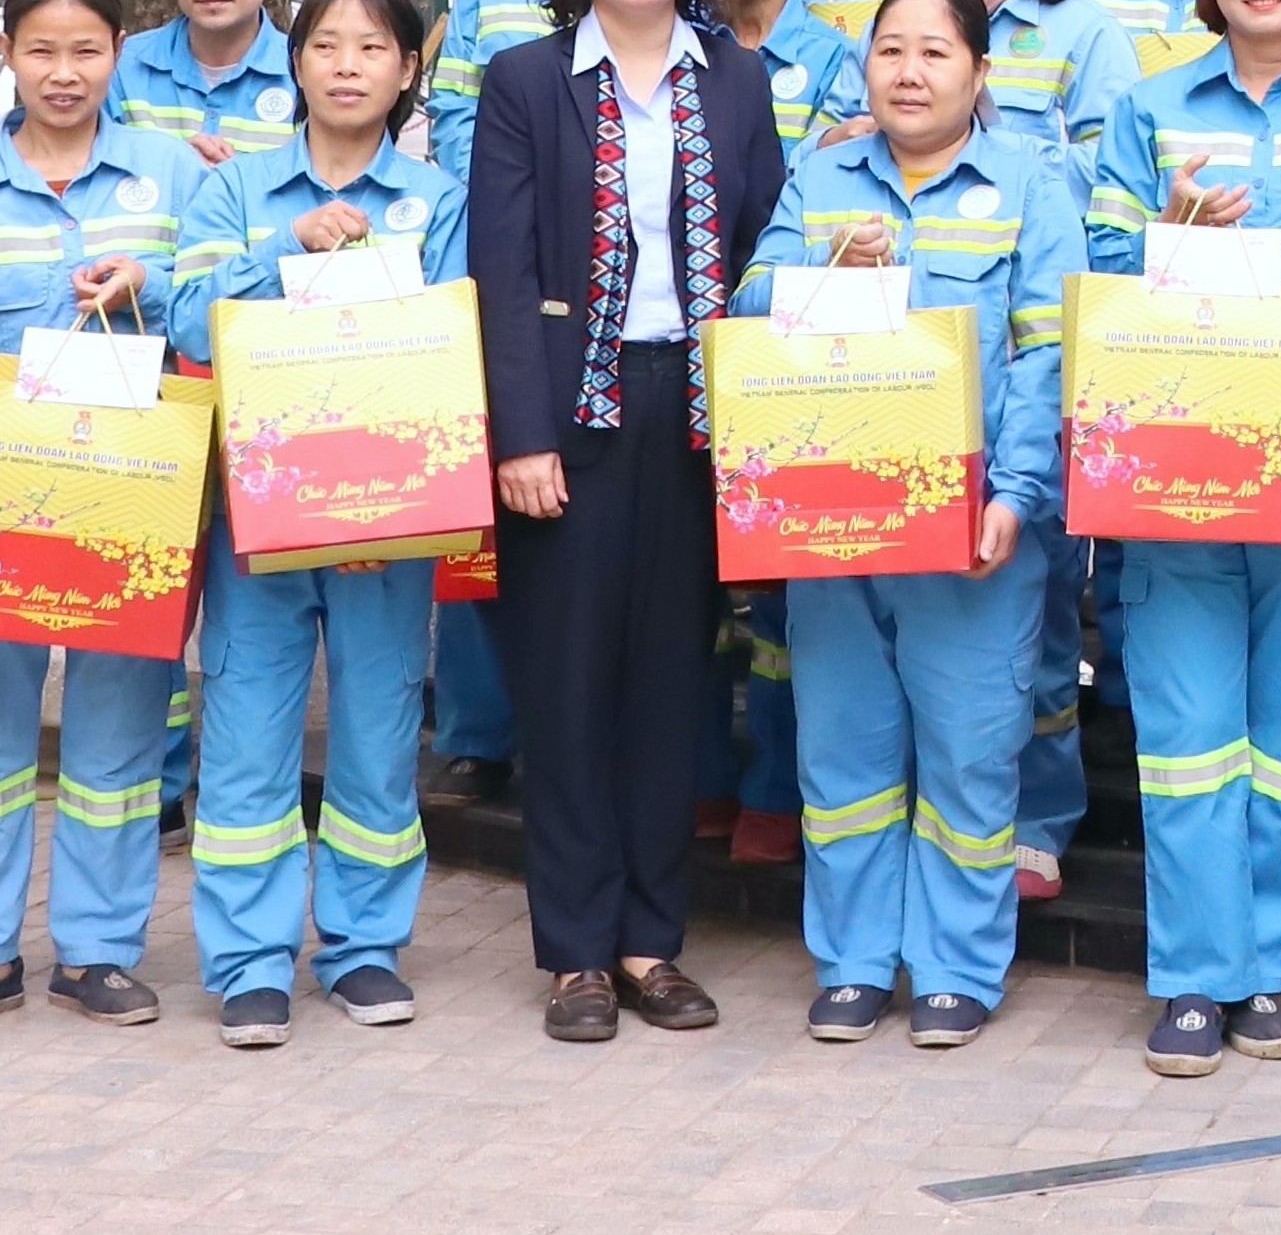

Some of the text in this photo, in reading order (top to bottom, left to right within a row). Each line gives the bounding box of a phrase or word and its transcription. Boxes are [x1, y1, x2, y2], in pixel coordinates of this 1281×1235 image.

[326, 500, 354, 510] HAPPY
[378, 495, 401, 504] YEAR
[1160, 497, 1188, 505] HAPPY
[1211, 499, 1234, 507] YEAR
[807, 536, 835, 544] HAPPY
[857, 534, 880, 542] YEAR
[18, 603, 47, 612] HAPPY
[70, 608, 93, 617] YEAR
